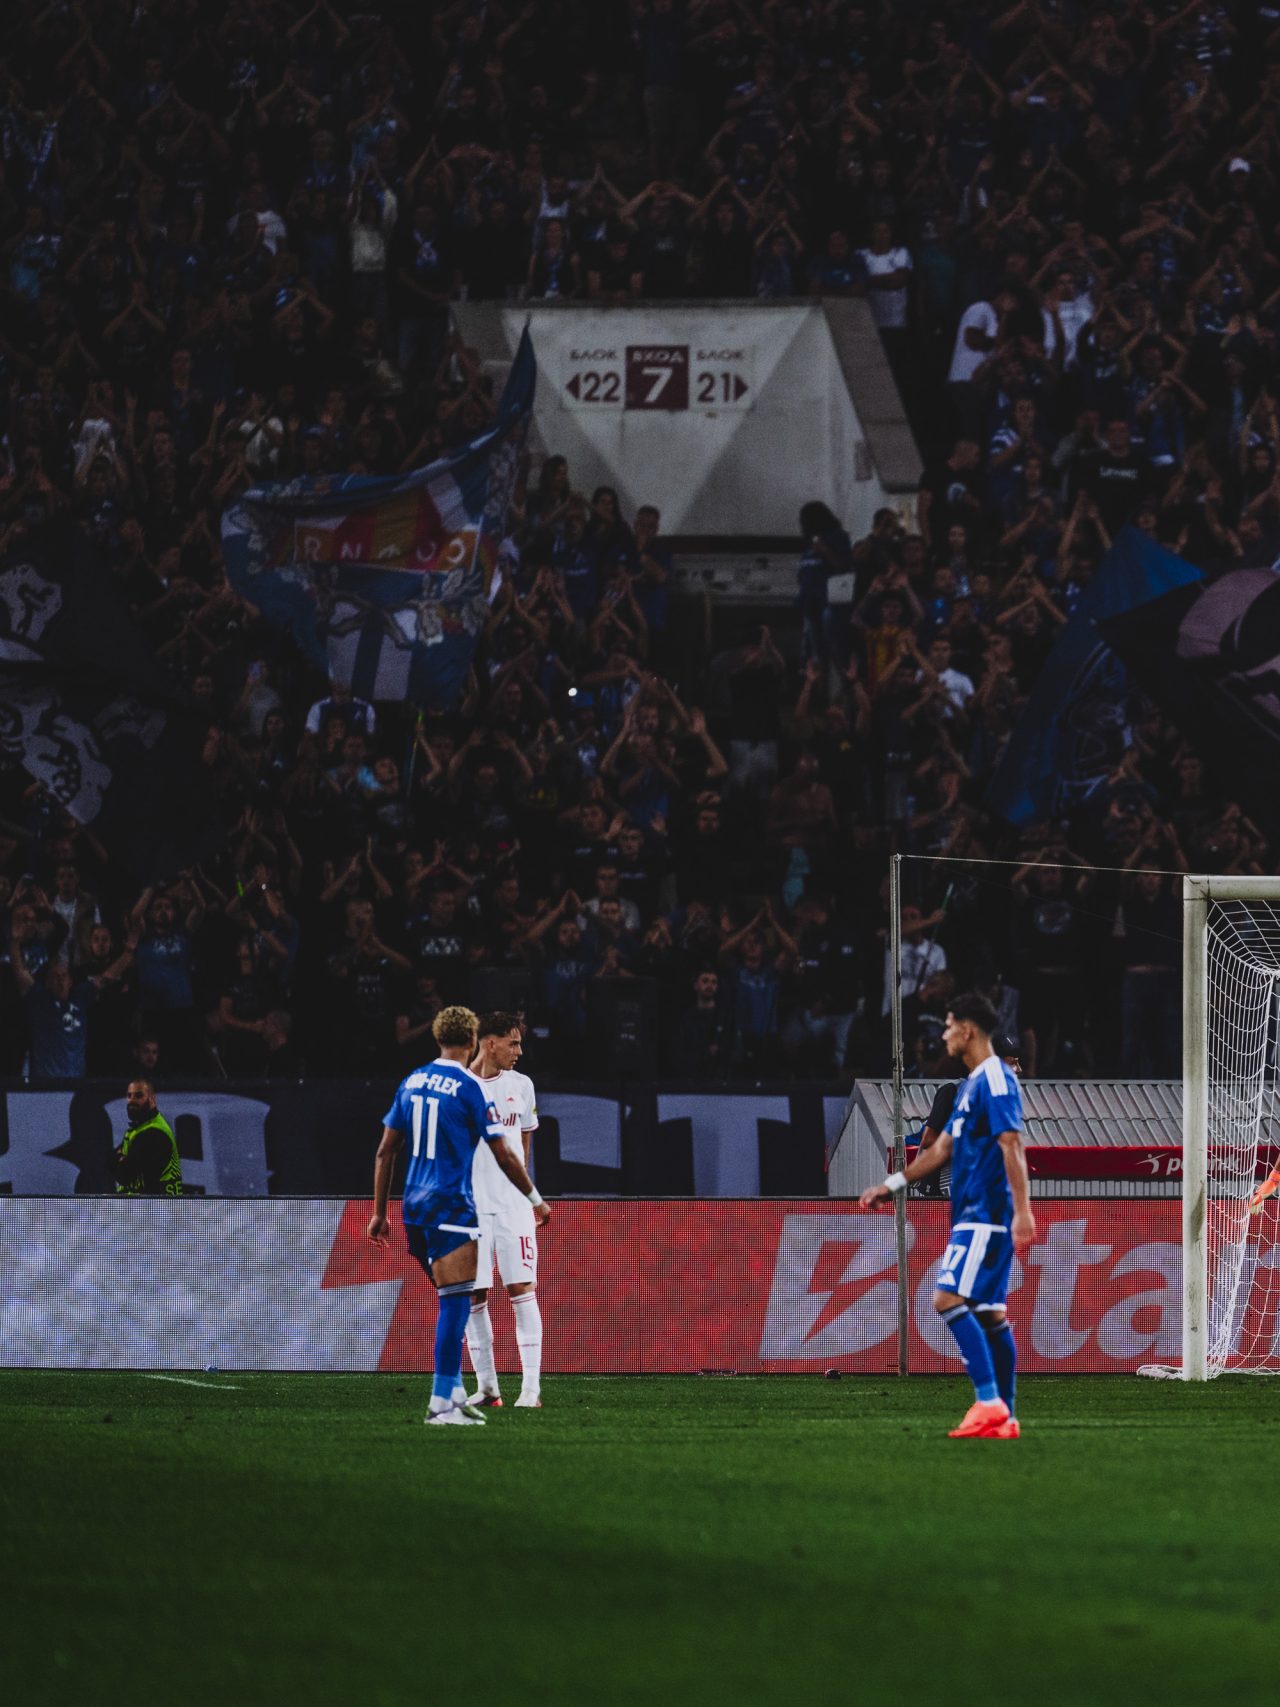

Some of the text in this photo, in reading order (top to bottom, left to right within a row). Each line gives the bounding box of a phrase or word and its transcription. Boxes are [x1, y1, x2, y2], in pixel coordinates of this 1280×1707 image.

[583, 372, 620, 402] 22
[641, 366, 673, 403] 7
[698, 372, 731, 402] 21
[410, 1094, 440, 1160] 11
[502, 1112, 517, 1127] ull
[519, 1236, 535, 1260] 15
